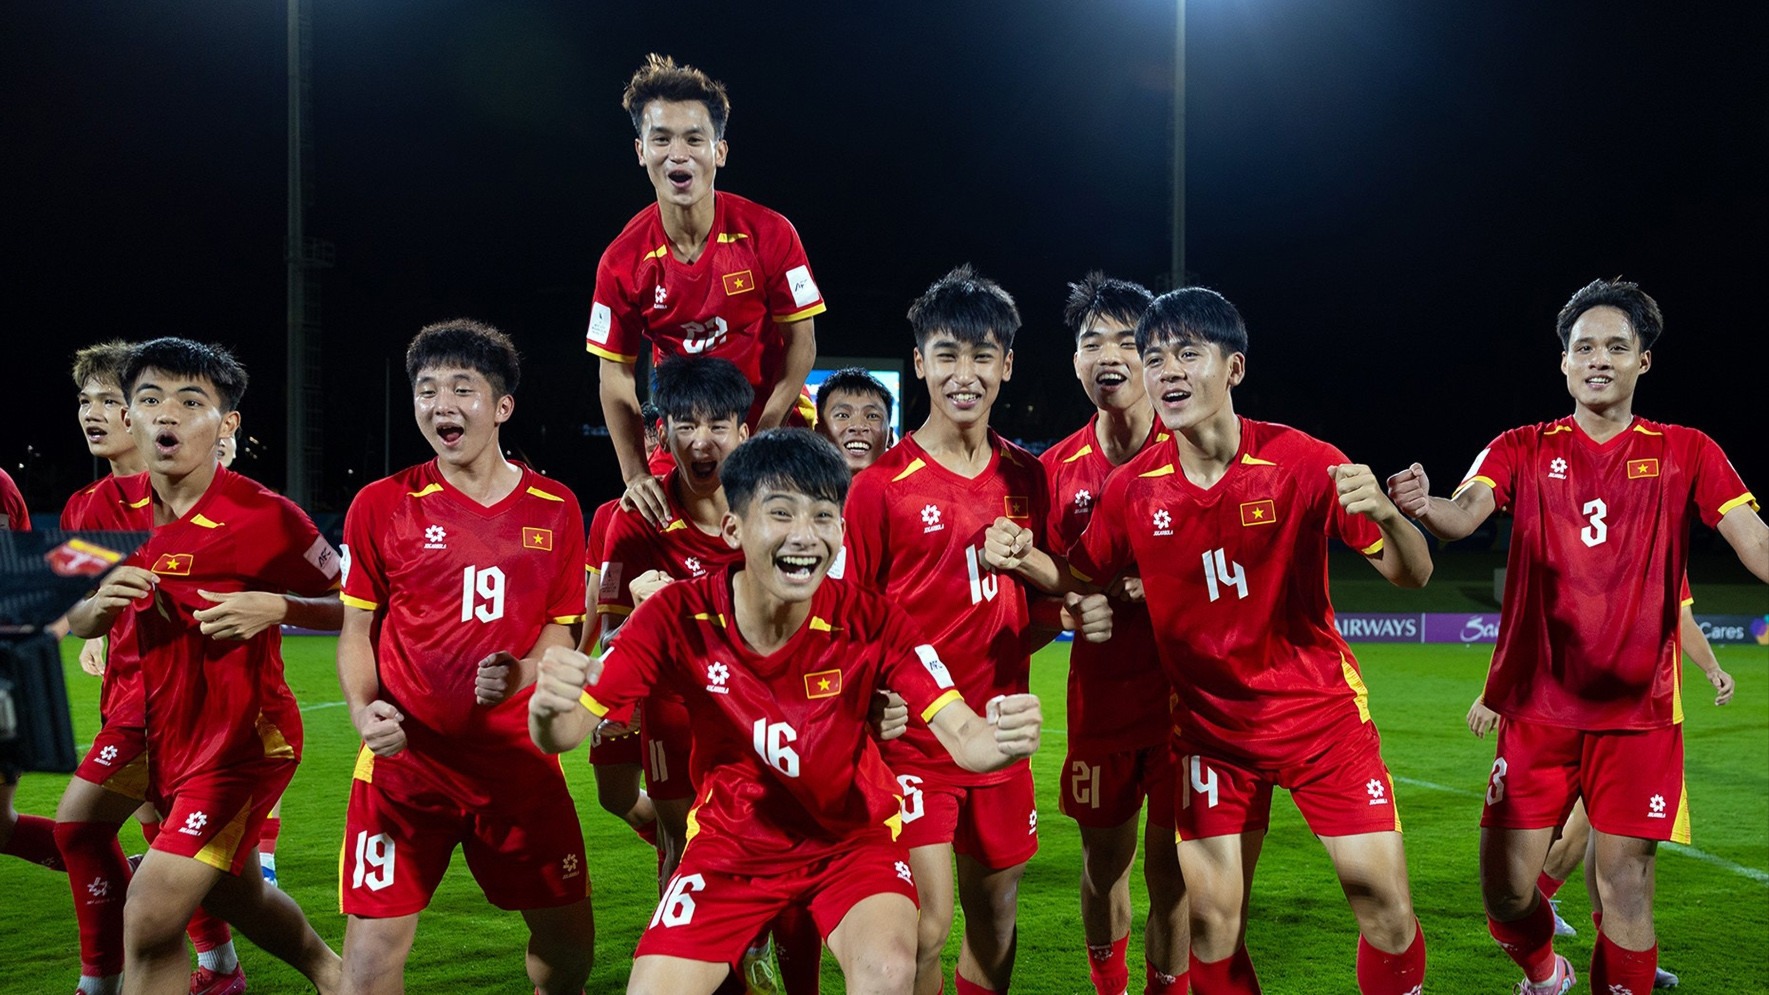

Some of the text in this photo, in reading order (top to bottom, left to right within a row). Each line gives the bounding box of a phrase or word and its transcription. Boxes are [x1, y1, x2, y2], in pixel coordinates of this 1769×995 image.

[1580, 497, 1608, 548] 3
[461, 564, 505, 623] 19
[1201, 547, 1249, 602] 14
[1700, 621, 1745, 640] Cares
[753, 718, 800, 778] 16
[1071, 760, 1101, 809] 21
[1182, 754, 1219, 811] 14
[1486, 756, 1508, 806] 3
[352, 830, 396, 892] 19
[649, 873, 706, 929] 16
